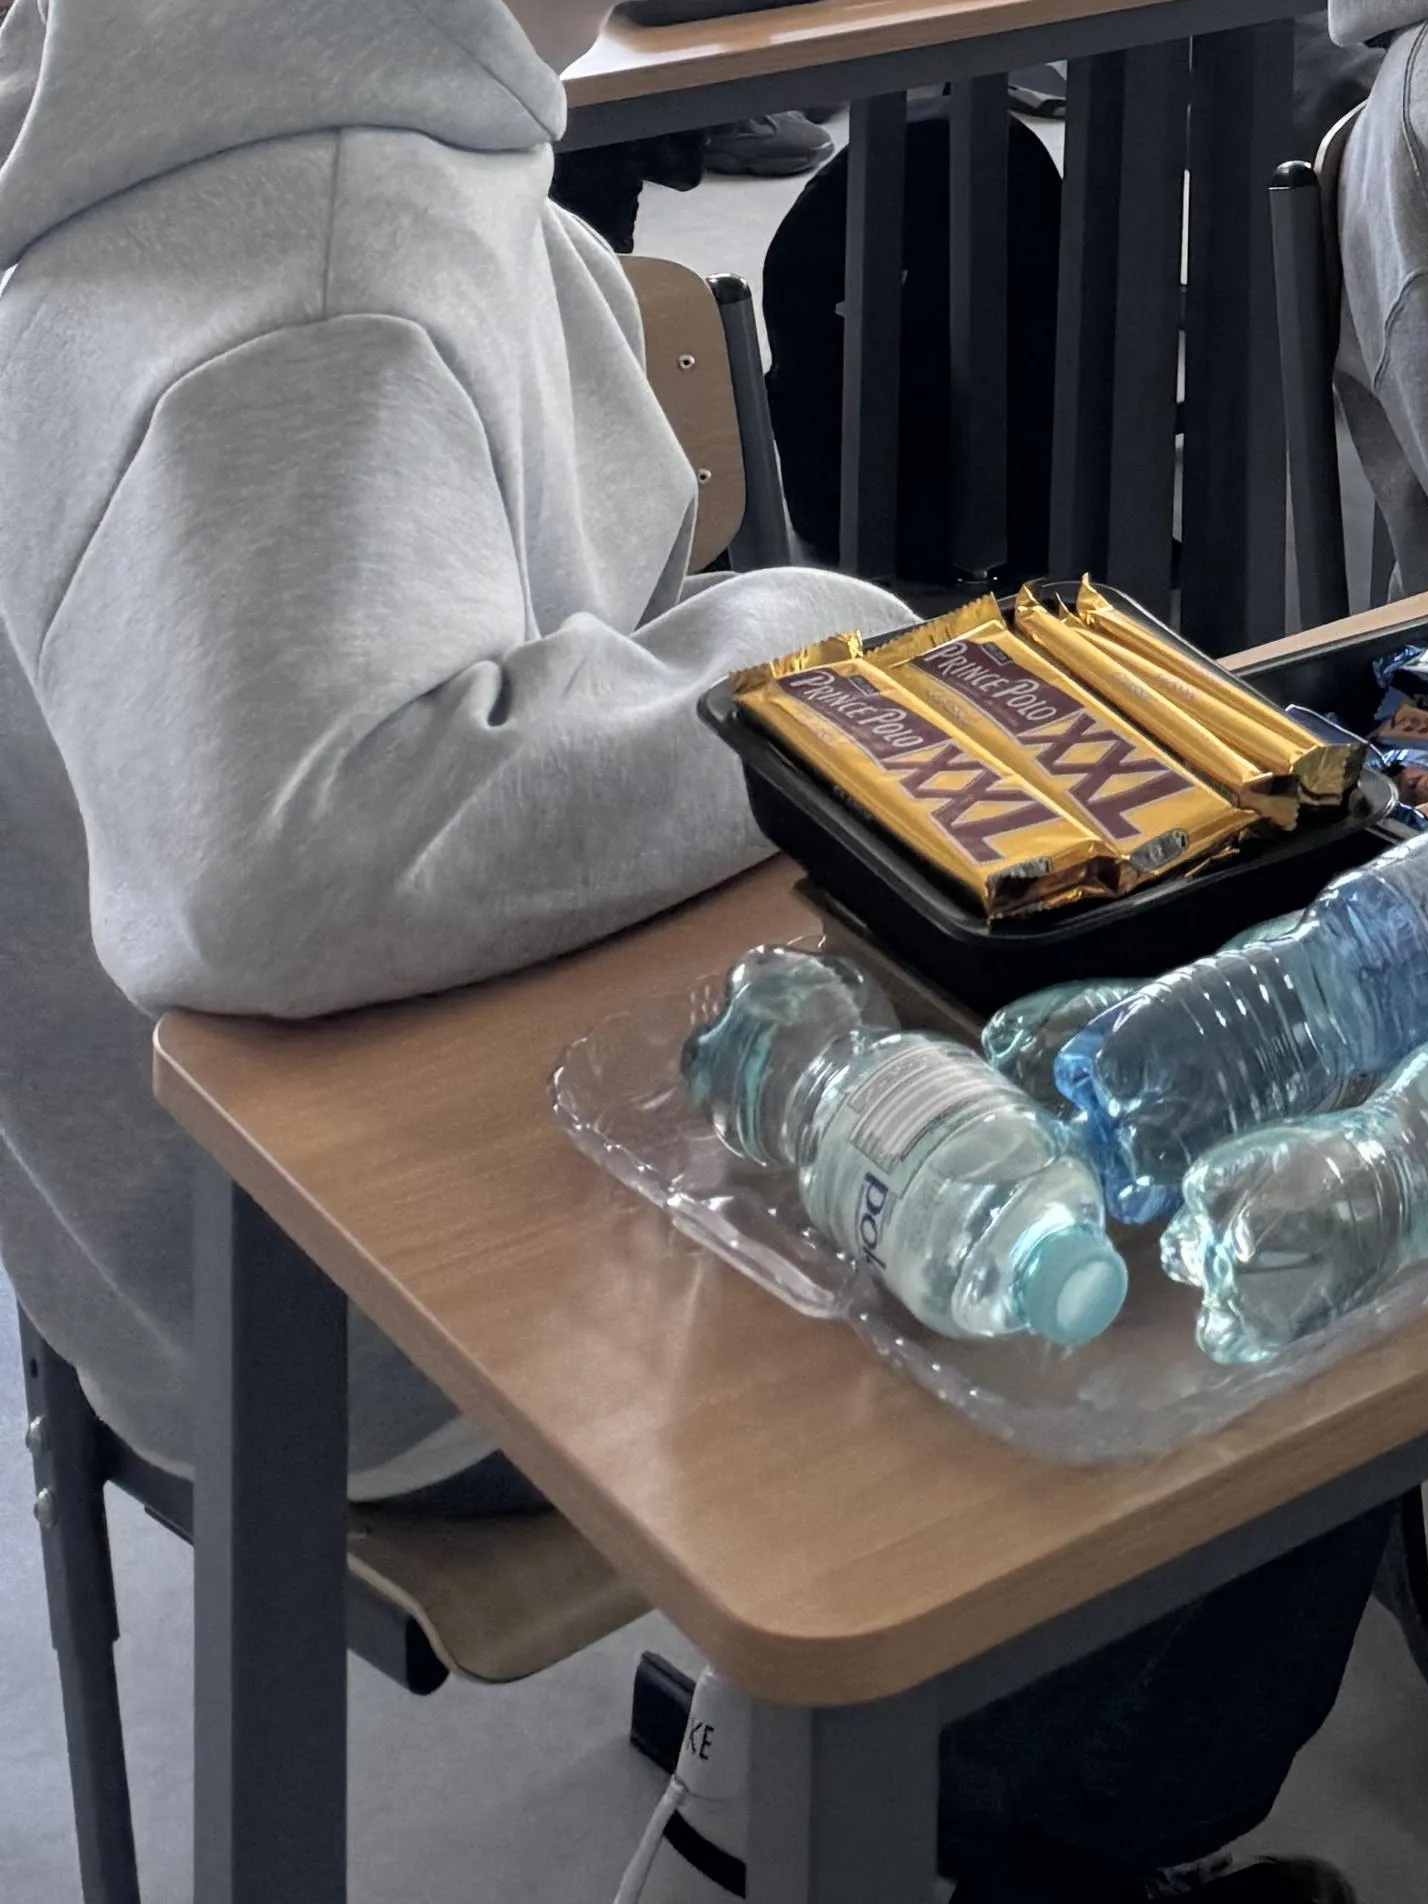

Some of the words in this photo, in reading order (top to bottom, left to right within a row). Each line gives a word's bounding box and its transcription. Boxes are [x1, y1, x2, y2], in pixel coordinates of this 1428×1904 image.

[788, 669, 873, 724] PRINCE
[865, 705, 925, 752] POLO
[924, 640, 1004, 700] PRINCE
[996, 679, 1058, 723] POLO
[881, 739, 1063, 864] XXL
[1018, 708, 1198, 842] XXL
